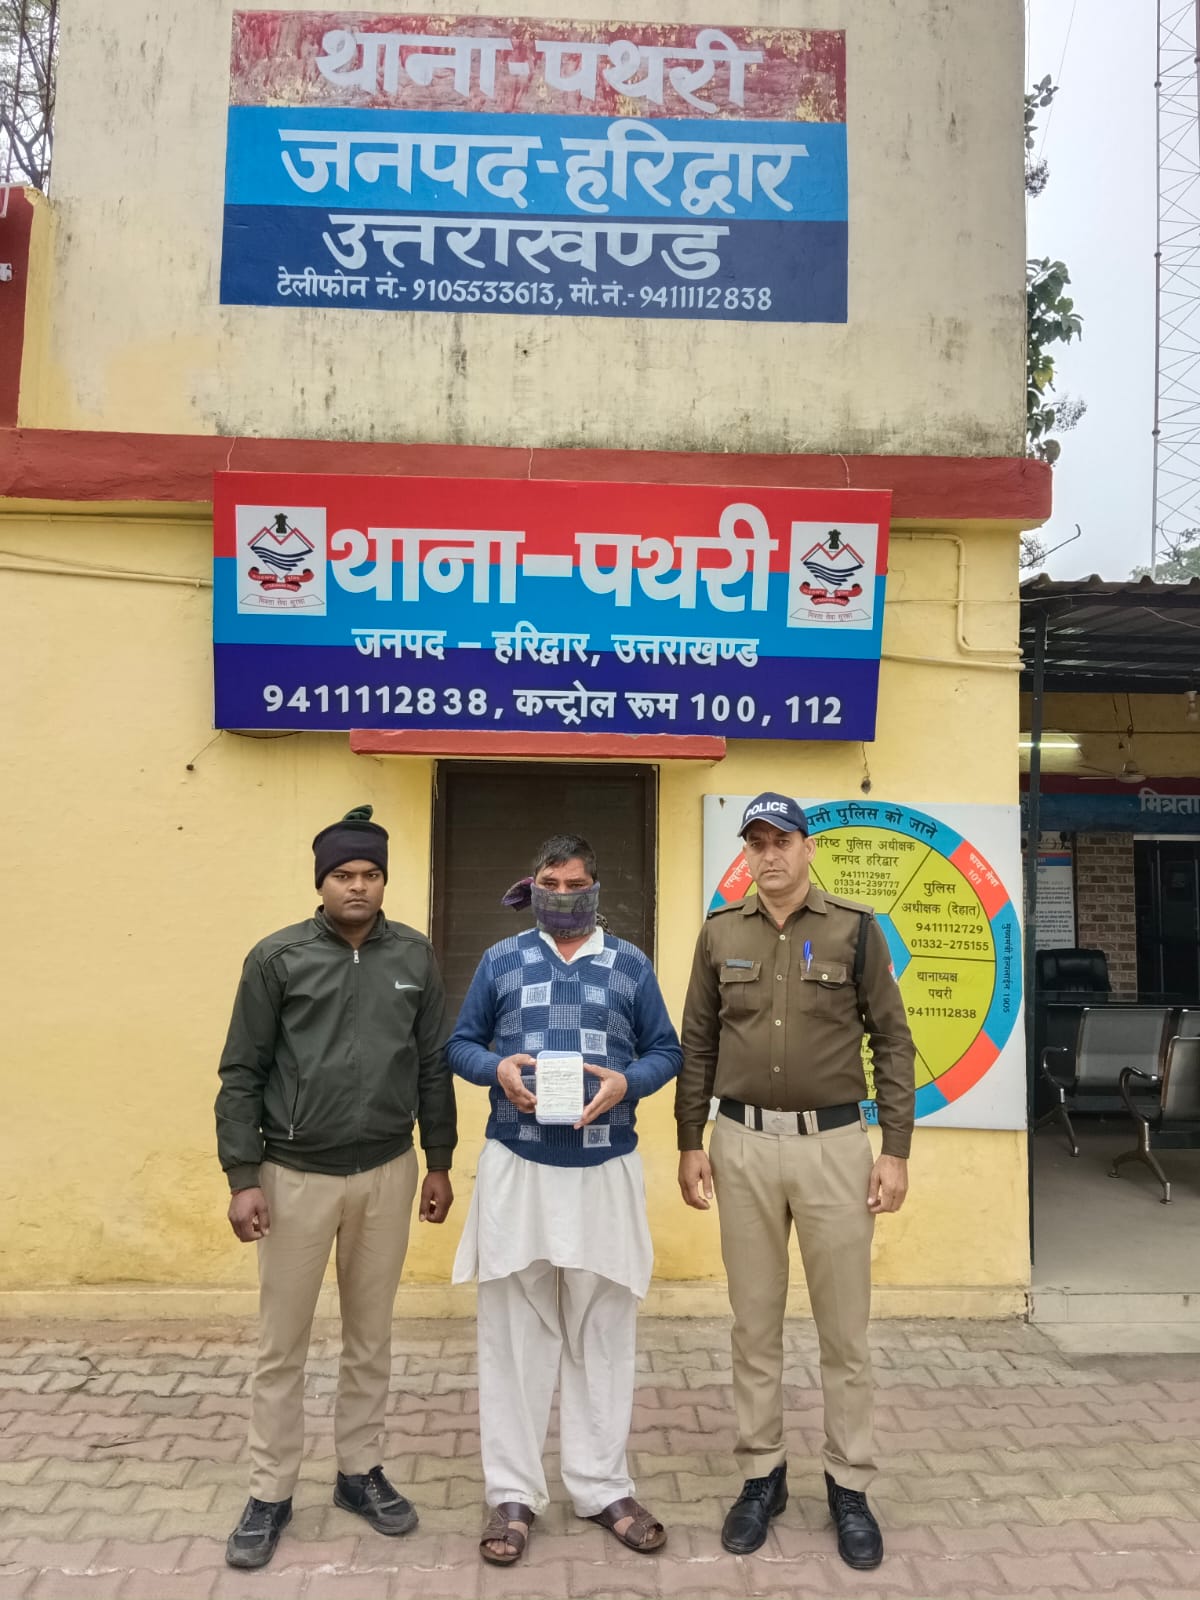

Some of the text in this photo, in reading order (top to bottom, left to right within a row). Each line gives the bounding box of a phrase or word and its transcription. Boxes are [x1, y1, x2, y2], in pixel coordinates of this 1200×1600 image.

[315, 29, 764, 113] थाना-पथरी
[278, 118, 808, 215] जनपद-हरिद्वार
[322, 213, 730, 280] उत्तराखण्ड
[277, 265, 370, 298] टेलीफोन
[639, 285, 772, 311] 9411112838
[351, 628, 445, 660] जनपद
[611, 634, 760, 668] उत्तराखण्ड
[262, 679, 842, 727] 9411112838, कन्ट्रोल रूम 100, 112
[745, 801, 789, 820] POLICE
[807, 803, 938, 839] पनी पुलिस को जाने
[846, 836, 873, 853] पुलिस
[877, 838, 917, 852] अधीक्षक
[831, 852, 900, 867] जनपद हरिद्वार
[840, 870, 892, 880] 9411112987
[968, 869, 982, 885] 101
[833, 887, 898, 897] 01334-239109
[834, 879, 900, 889] 01334-239777
[923, 880, 957, 897] पुलिस
[901, 900, 981, 919] अधीक्षक (देहात)
[915, 922, 984, 935] 9411112729
[910, 938, 990, 952] 01332-275155
[916, 971, 959, 983] थानाध्यक्ष
[928, 986, 953, 1000] पथरी
[907, 1006, 977, 1019] 9411112838
